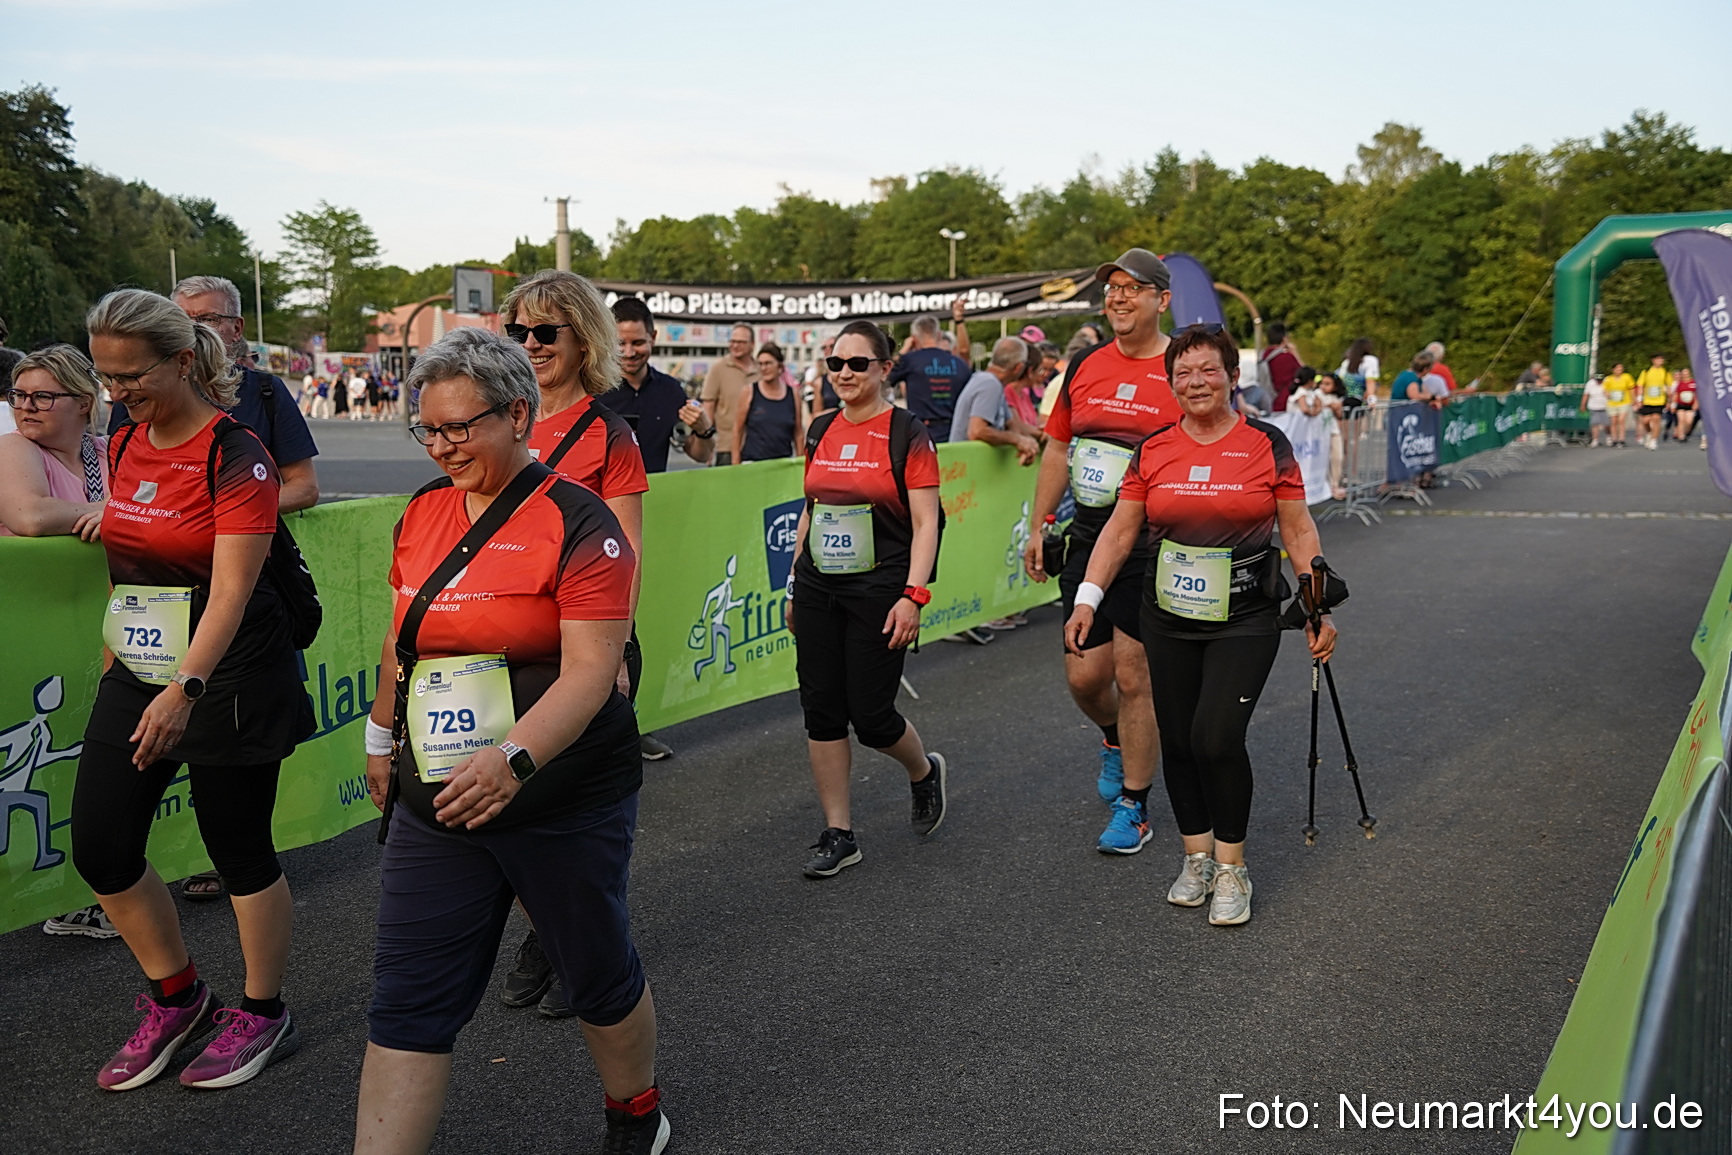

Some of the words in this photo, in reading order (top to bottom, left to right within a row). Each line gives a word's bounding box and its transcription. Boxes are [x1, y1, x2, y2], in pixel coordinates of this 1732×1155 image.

[647, 291, 686, 314] die
[688, 292, 768, 315] Plätze.
[770, 292, 848, 320] Fertig.
[1131, 402, 1160, 415] PARTNER
[853, 460, 880, 469] PARTNER
[1082, 467, 1105, 483] 726
[1173, 489, 1219, 497] STEUERBERATER
[1209, 483, 1243, 491] PARTNER
[114, 511, 152, 524] STEUERBERATER
[141, 507, 147, 515] &
[149, 508, 182, 519] PARTNER
[822, 534, 852, 548] 728
[1172, 574, 1206, 592] 730
[441, 592, 450, 602] &
[1180, 593, 1220, 604] Moosburger
[428, 603, 461, 612] RBERATER
[123, 626, 163, 648] 732
[117, 650, 142, 660] Verena
[143, 653, 177, 663] Schröder
[426, 681, 452, 691] Firmenlauf
[427, 708, 476, 735] 729
[422, 742, 463, 753] Susanne
[464, 737, 495, 749] Meier
